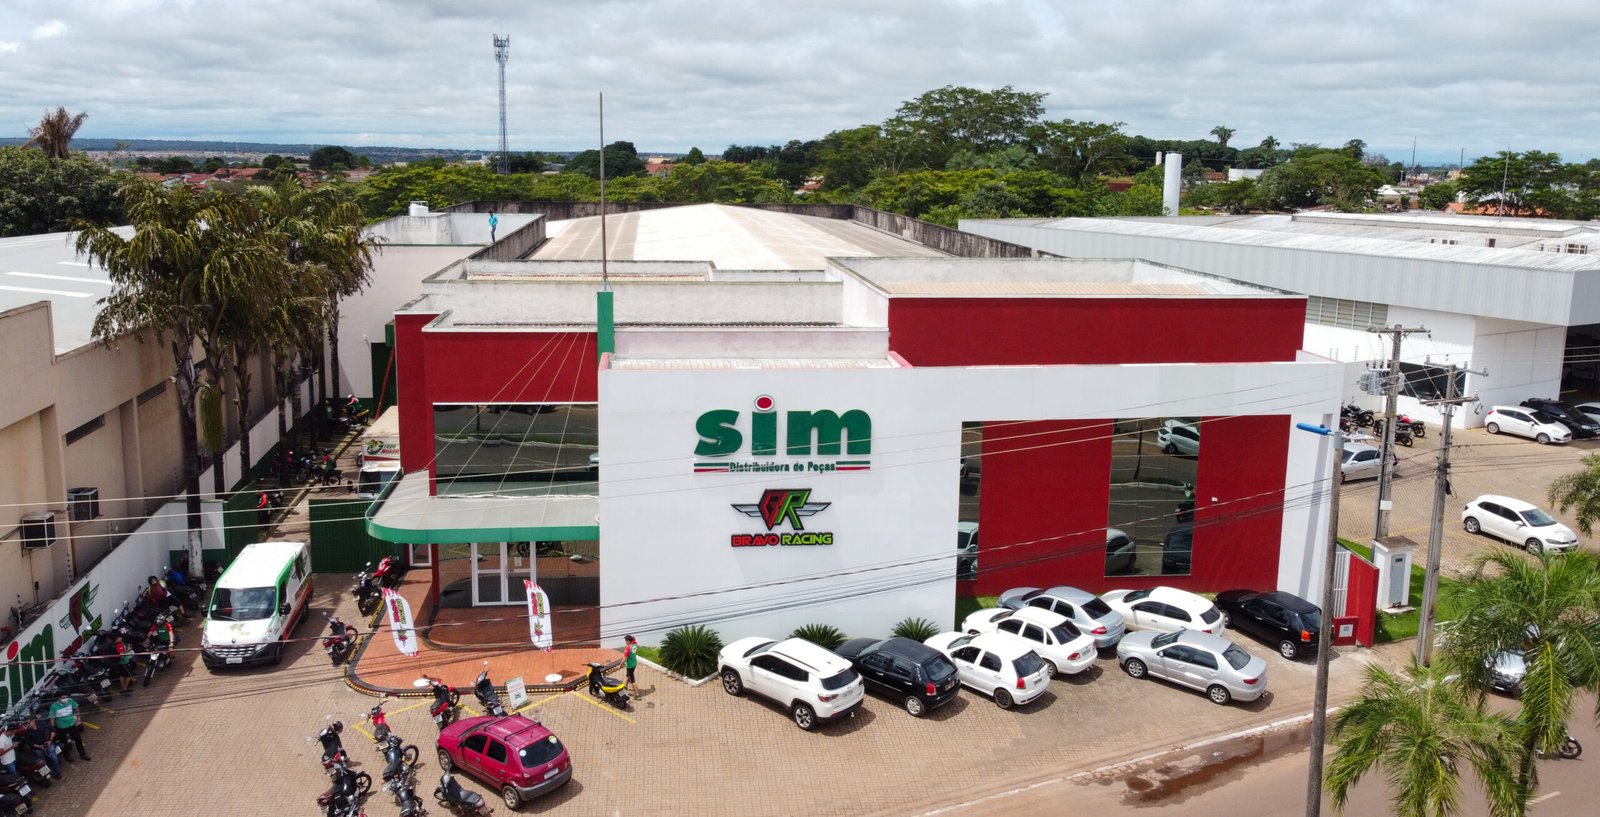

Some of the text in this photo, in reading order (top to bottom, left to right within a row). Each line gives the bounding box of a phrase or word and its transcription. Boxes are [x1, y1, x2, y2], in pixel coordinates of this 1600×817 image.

[695, 395, 872, 457] sim
[729, 461, 836, 473] Distribuidora de Peças
[731, 532, 833, 547] BRAVO RACING
